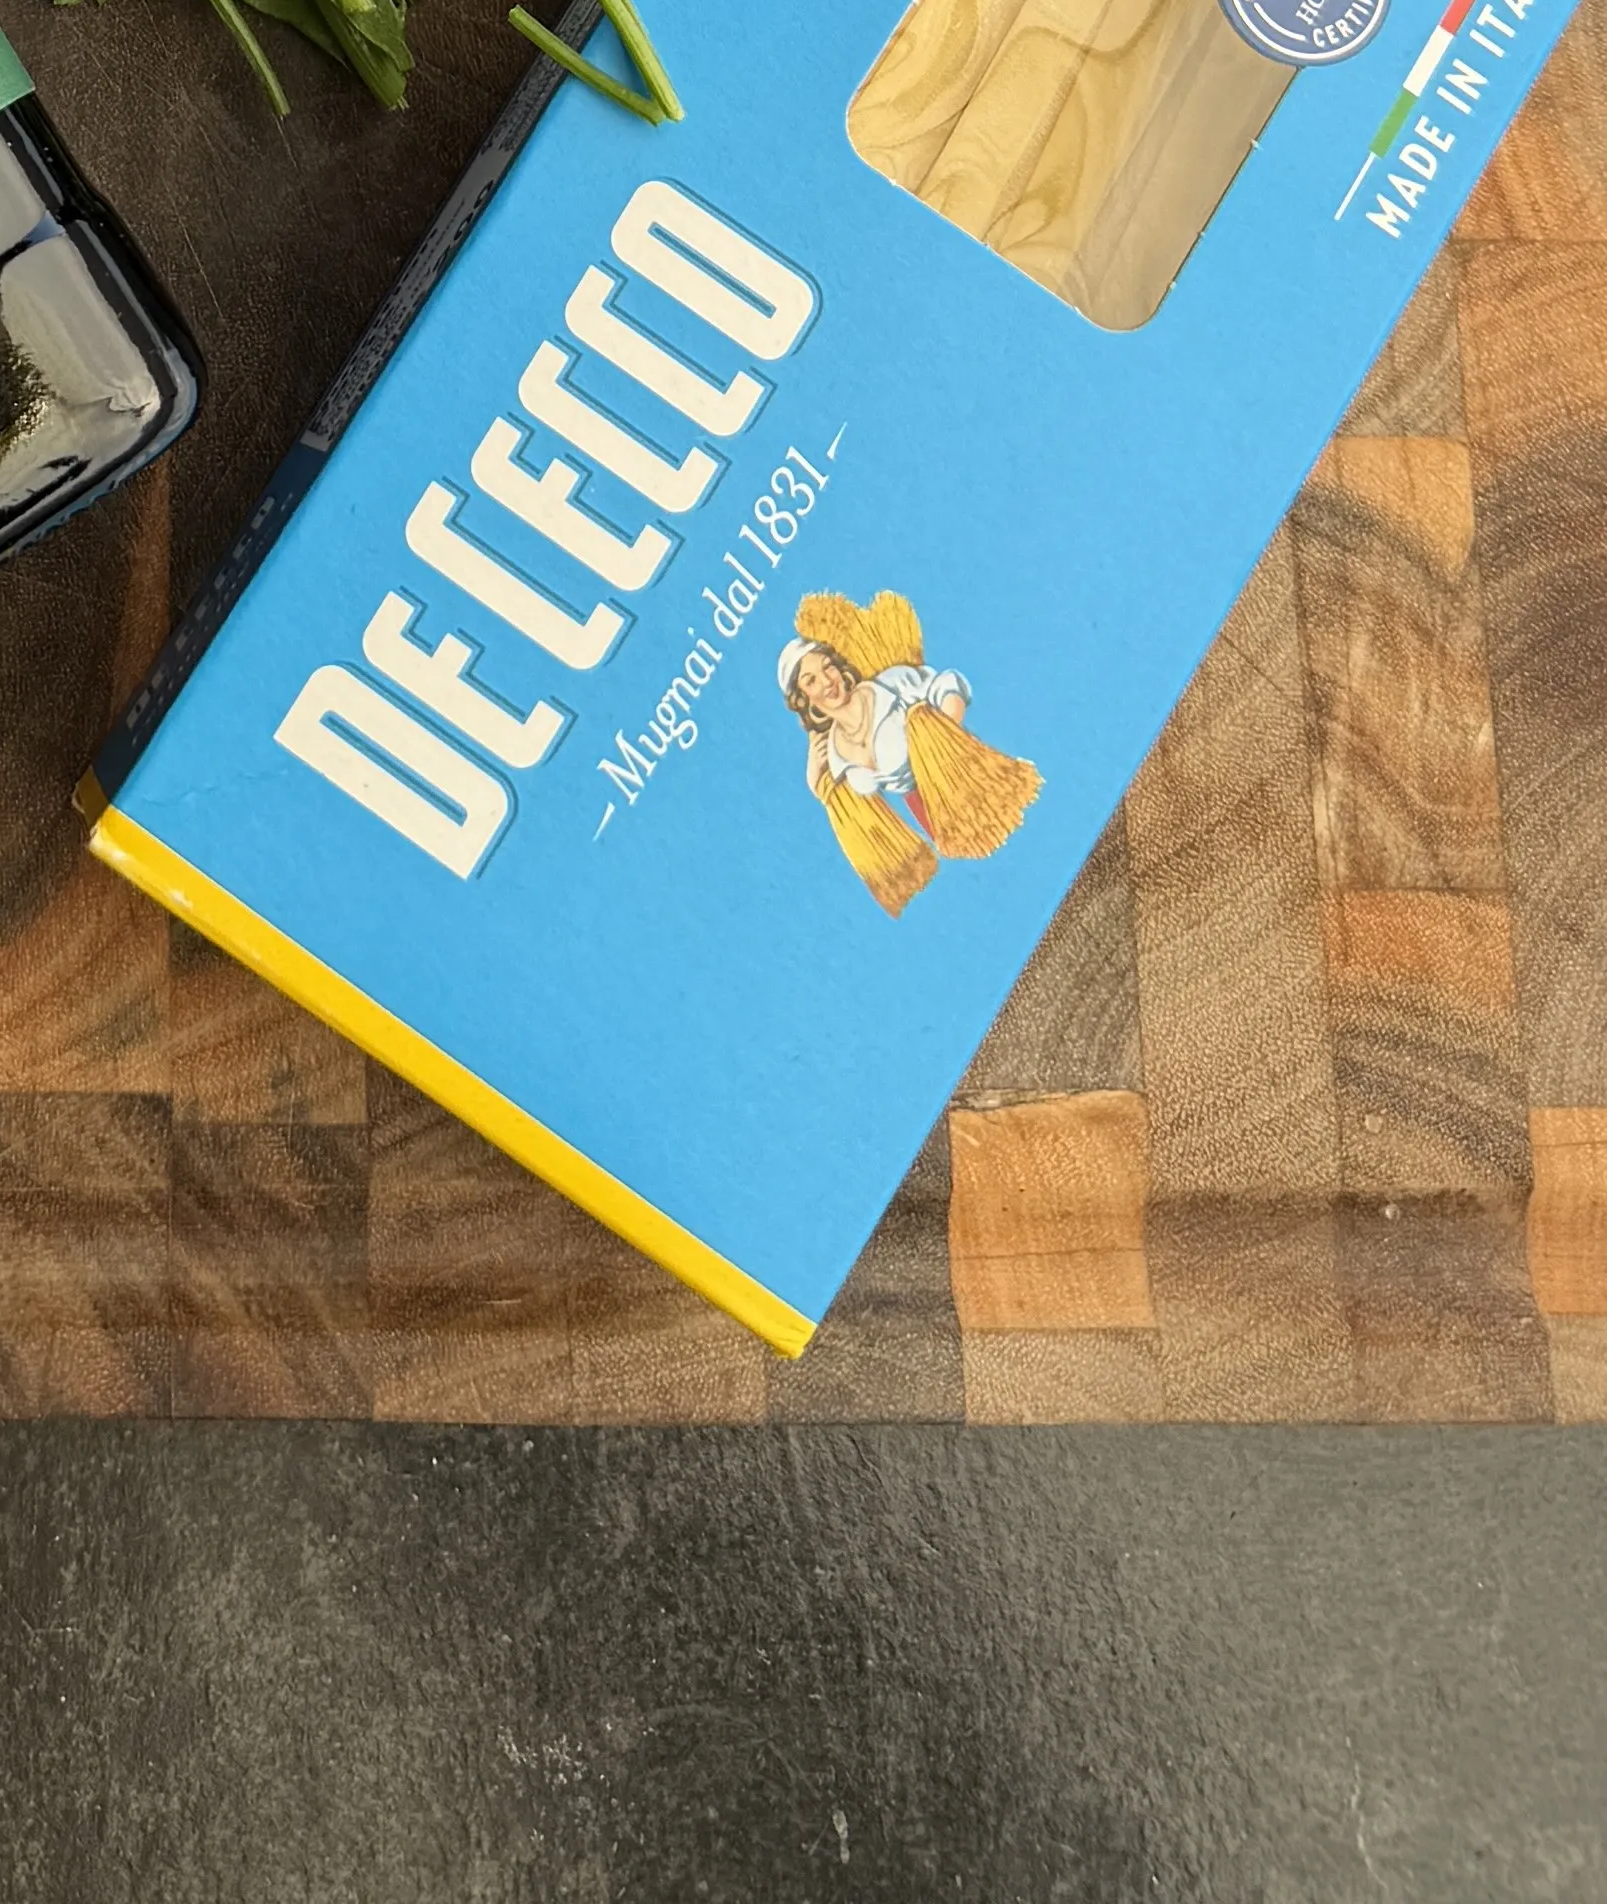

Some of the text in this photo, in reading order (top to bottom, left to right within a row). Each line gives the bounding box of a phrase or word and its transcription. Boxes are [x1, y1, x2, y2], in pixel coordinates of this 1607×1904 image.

[1365, 114, 1456, 239] MADE
[1436, 58, 1490, 115] IN
[596, 445, 831, 806] Mugnai dal 1831
